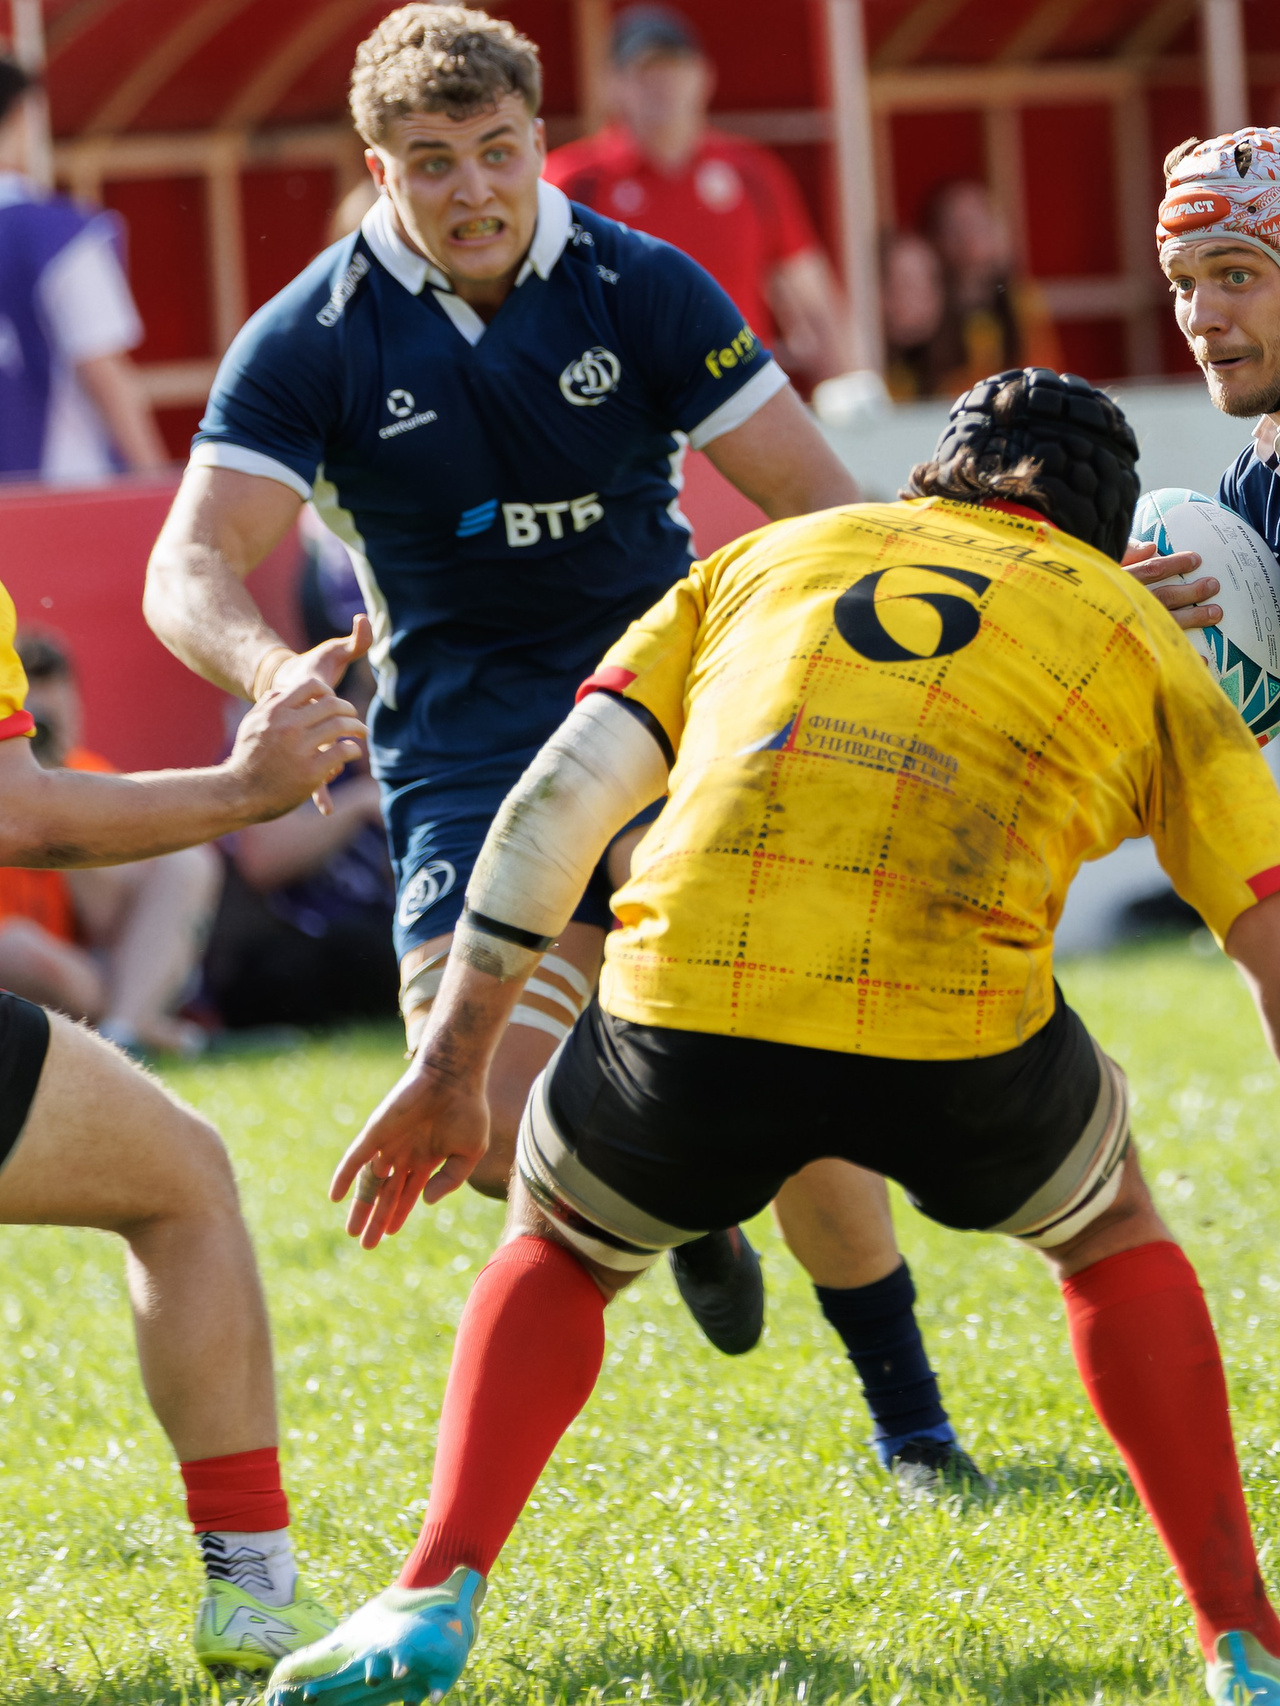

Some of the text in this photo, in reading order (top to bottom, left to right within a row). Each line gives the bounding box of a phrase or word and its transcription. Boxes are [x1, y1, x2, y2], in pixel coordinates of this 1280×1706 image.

[1161, 200, 1215, 222] IMPACT
[502, 493, 604, 547] ВТБ
[1255, 555, 1271, 584] ЖИЗНЬ
[834, 564, 992, 662] 6
[808, 715, 959, 773] ФИНАНСОВЫЙ
